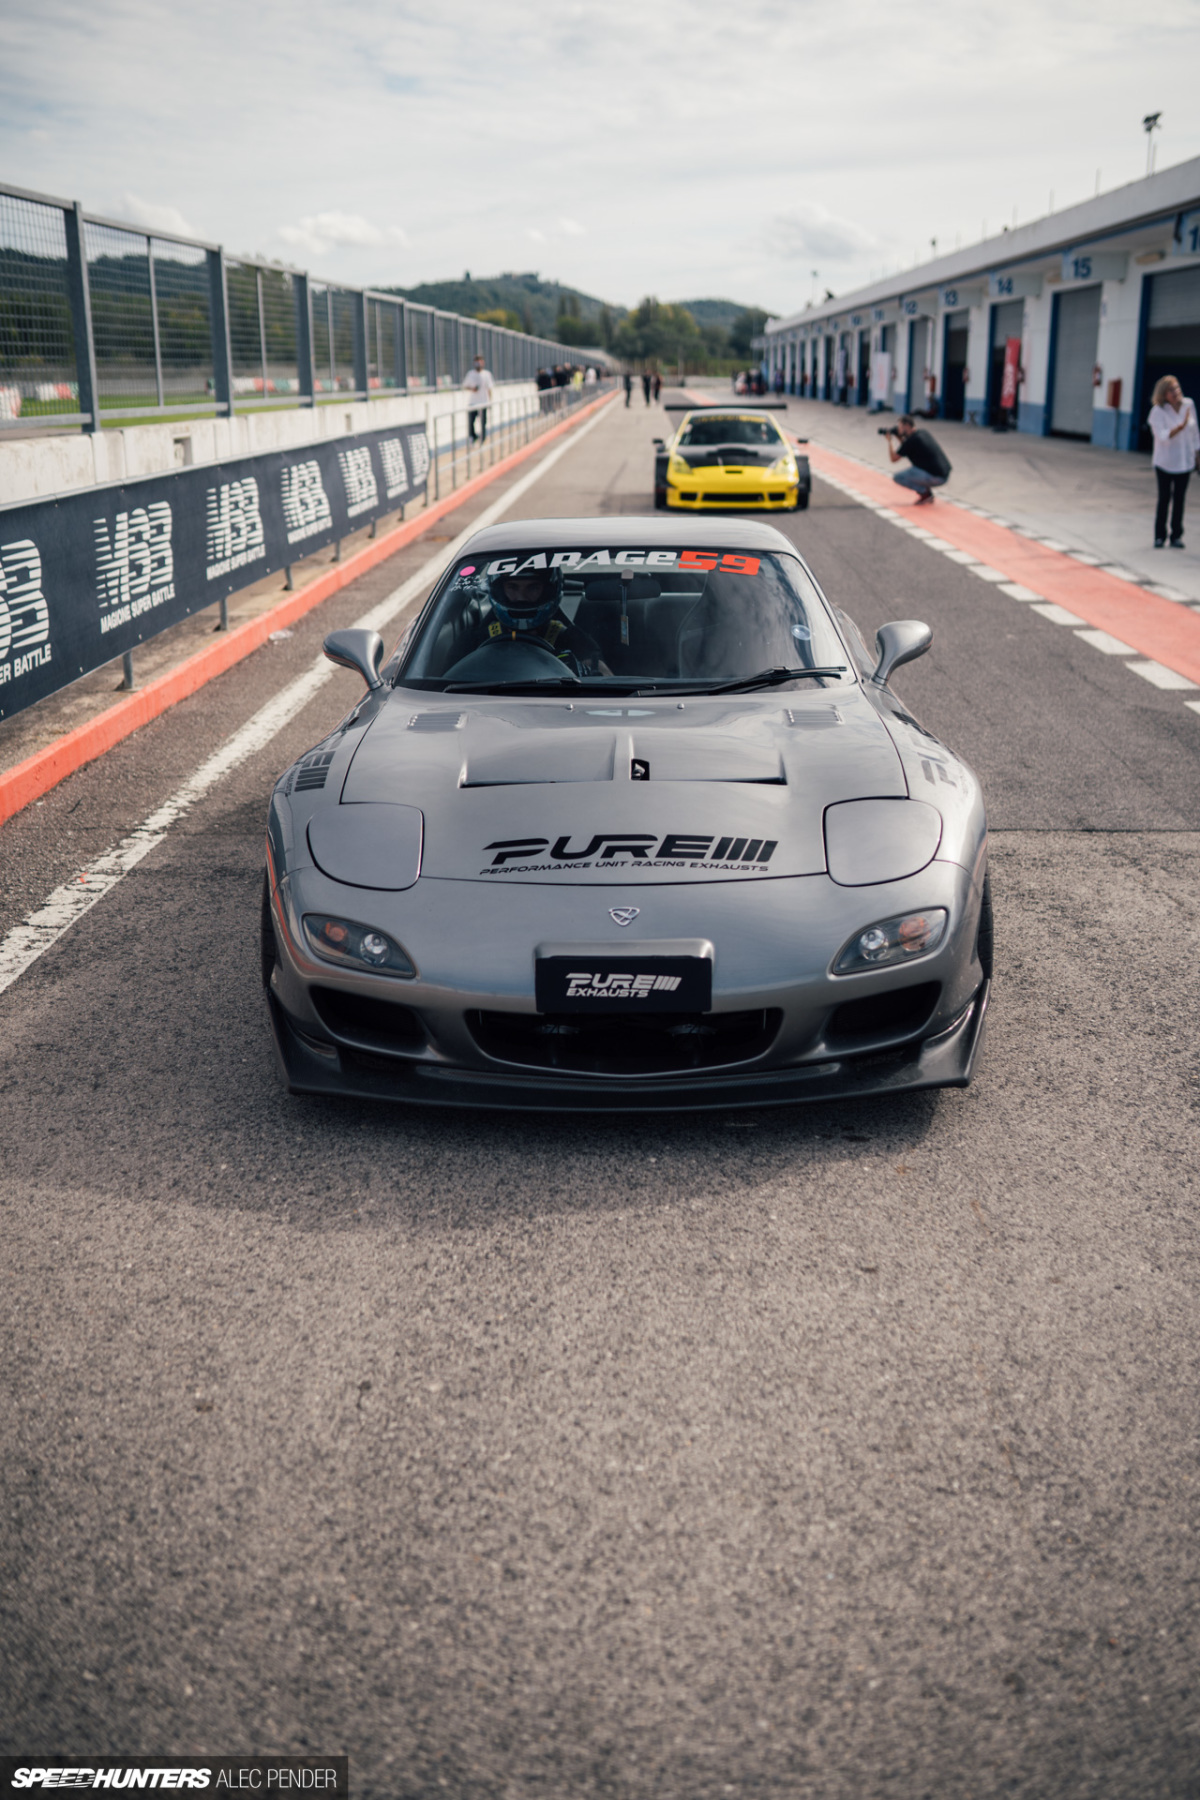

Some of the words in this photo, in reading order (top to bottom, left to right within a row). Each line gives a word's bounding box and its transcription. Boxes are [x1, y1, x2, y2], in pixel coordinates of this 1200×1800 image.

[1072, 257, 1092, 278] 15
[997, 277, 1013, 294] 14
[101, 604, 131, 634] MAGIONE
[131, 594, 152, 618] SUPER
[152, 583, 175, 607] BATTLE
[14, 643, 52, 678] BATTLE
[479, 862, 592, 875] PERFORMANCE
[595, 860, 628, 868] UNIT
[631, 860, 686, 868] RACING
[690, 862, 769, 872] EXHAUSTS
[566, 988, 650, 998] EXHAUSTS
